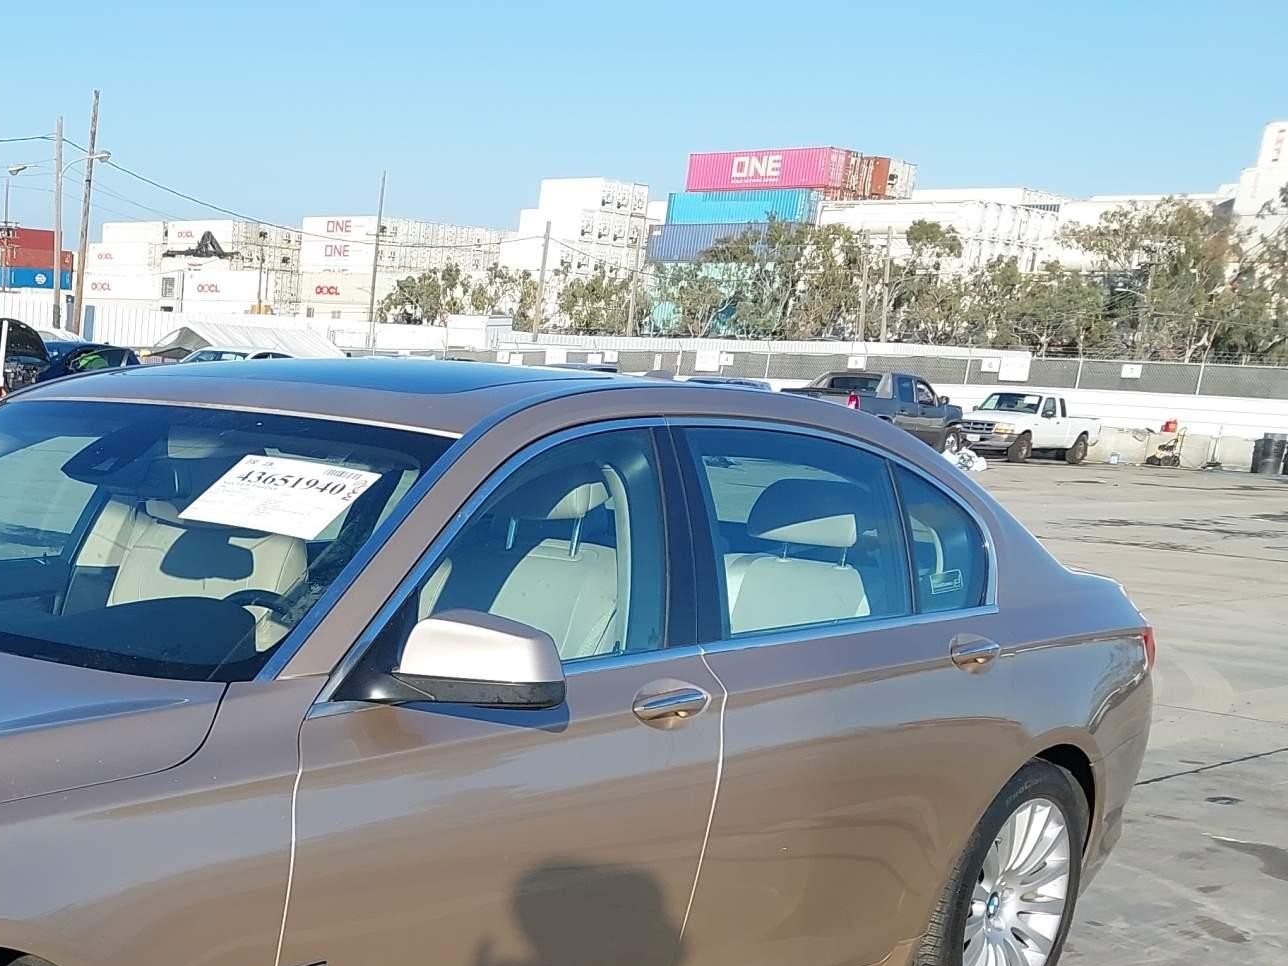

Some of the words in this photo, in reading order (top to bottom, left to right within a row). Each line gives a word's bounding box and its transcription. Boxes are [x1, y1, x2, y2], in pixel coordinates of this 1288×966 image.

[730, 154, 782, 177] ONE
[326, 220, 352, 233] ONE
[324, 244, 350, 257] ONE
[91, 282, 112, 291] OOCL
[196, 284, 221, 293] OOCL
[315, 285, 340, 296] OOCL
[236, 470, 346, 496] 43651940
